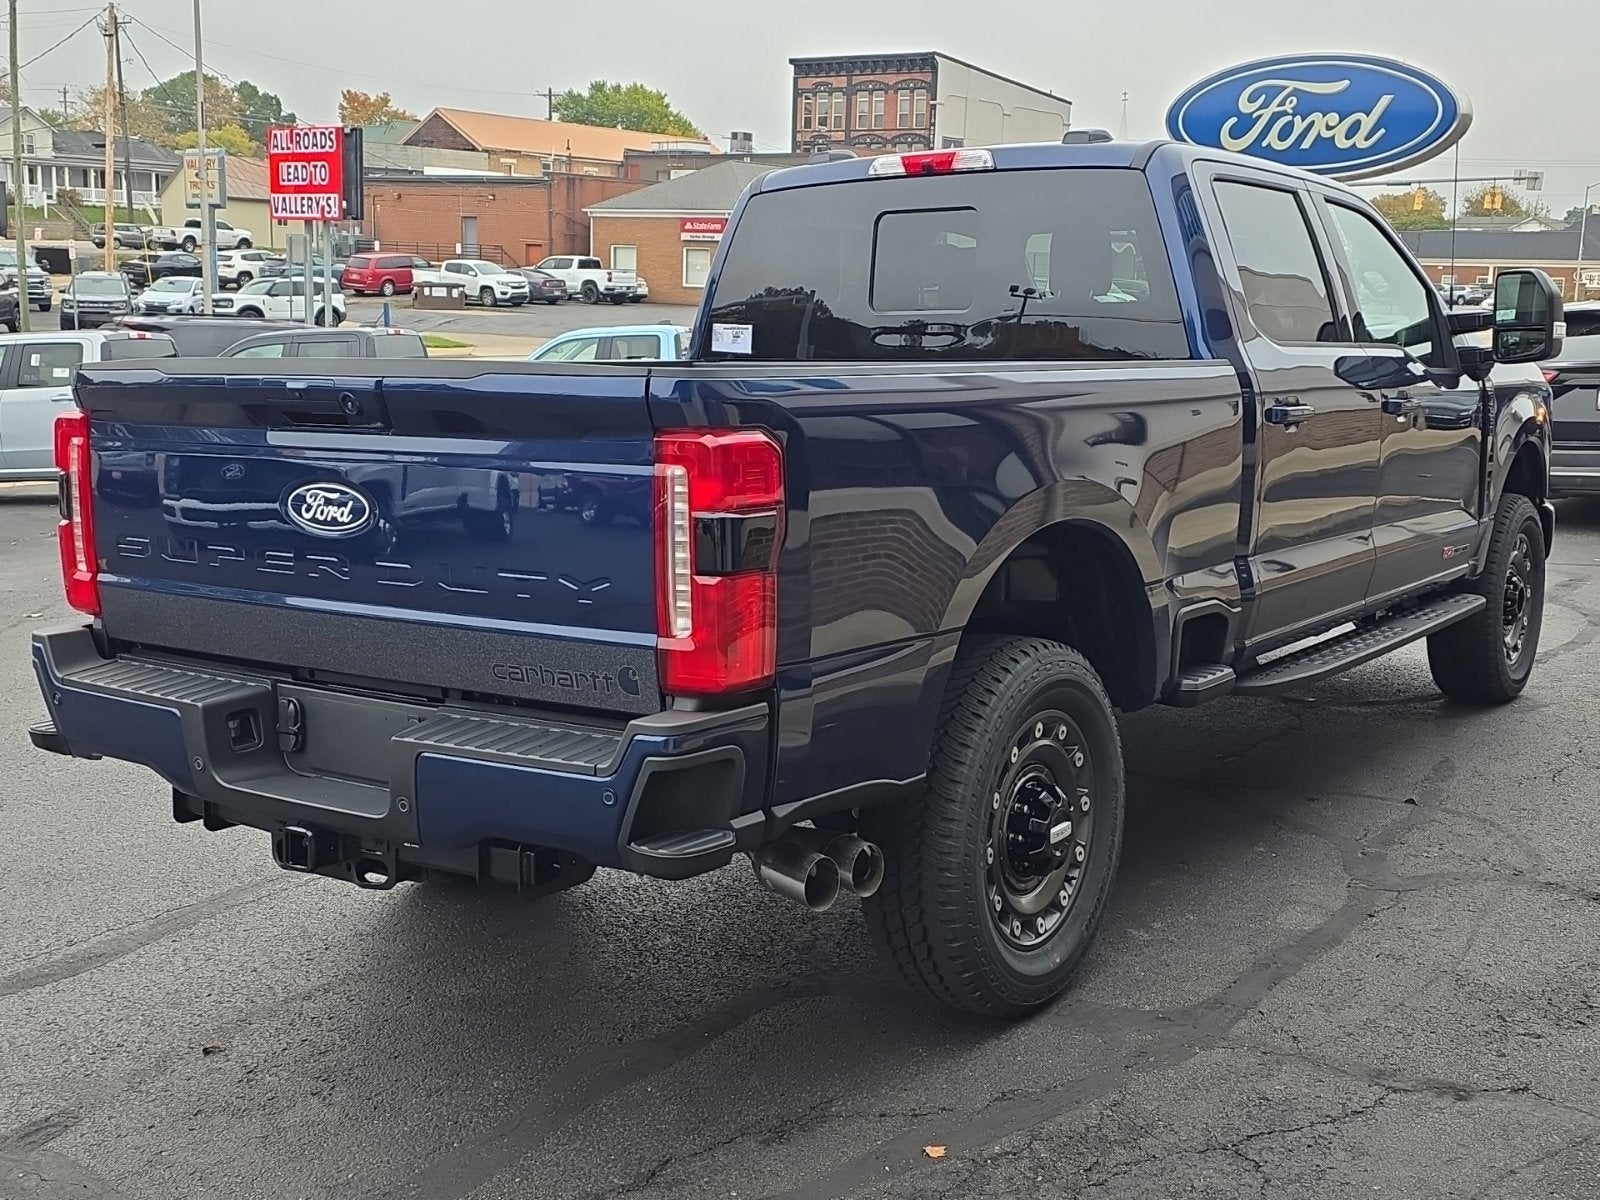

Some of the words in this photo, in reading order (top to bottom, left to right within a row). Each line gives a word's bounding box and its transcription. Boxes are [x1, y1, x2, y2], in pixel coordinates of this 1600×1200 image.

[1220, 79, 1395, 151] Ford
[272, 131, 291, 151] ALL
[294, 130, 335, 151] ROADS
[280, 163, 309, 183] LEAD
[312, 163, 328, 183] TO
[272, 195, 338, 215] VALLERY'S!
[301, 489, 354, 522] Ford
[117, 535, 350, 580] SUPER
[375, 555, 611, 604] DUTY
[491, 663, 614, 693] carhartt
